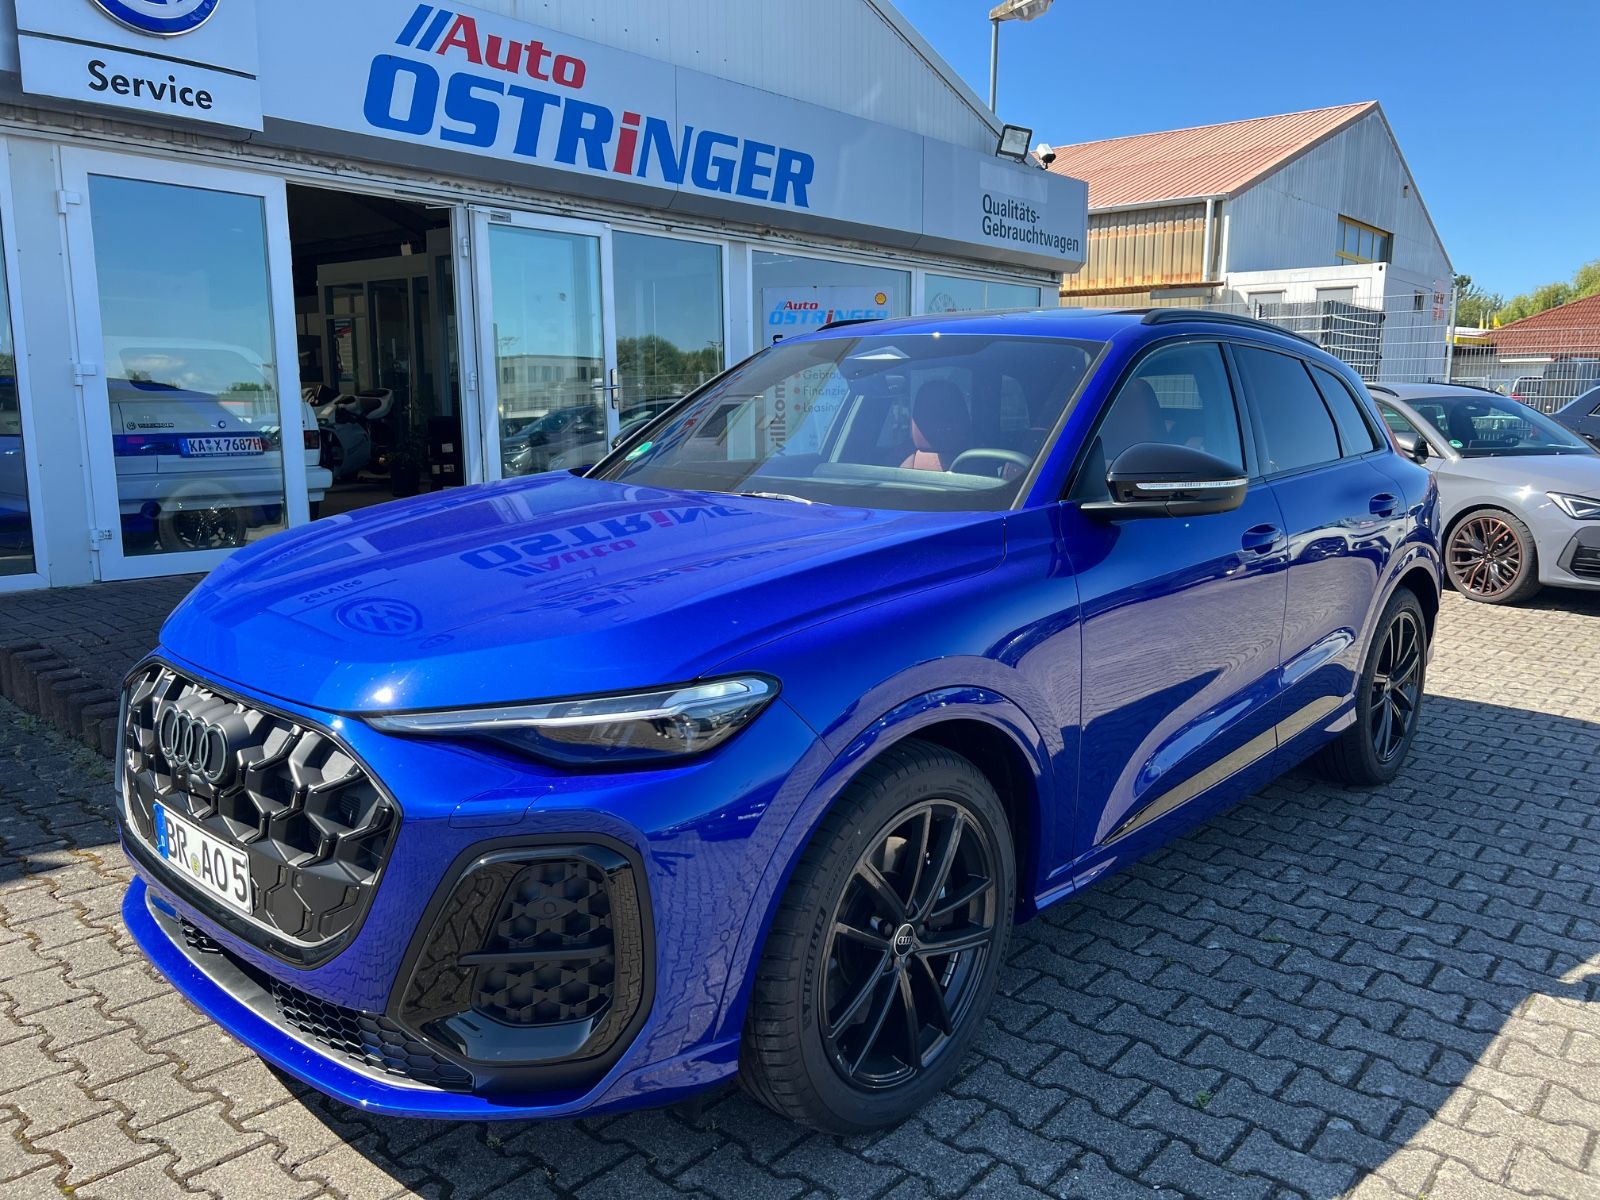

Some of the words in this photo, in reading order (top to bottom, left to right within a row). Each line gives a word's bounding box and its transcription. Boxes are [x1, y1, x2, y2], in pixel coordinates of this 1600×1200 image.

[436, 13, 586, 89] Auto
[87, 59, 213, 110] Service
[363, 54, 815, 208] OSTRiNGER
[982, 193, 1040, 223] Qualitäts-
[982, 215, 1079, 253] Gebrauchtwagen
[783, 300, 818, 311] Auto
[189, 439, 206, 453] KA
[214, 439, 223, 452] X
[166, 816, 190, 869] BR
[202, 840, 228, 892] AO
[231, 856, 248, 903] 5
